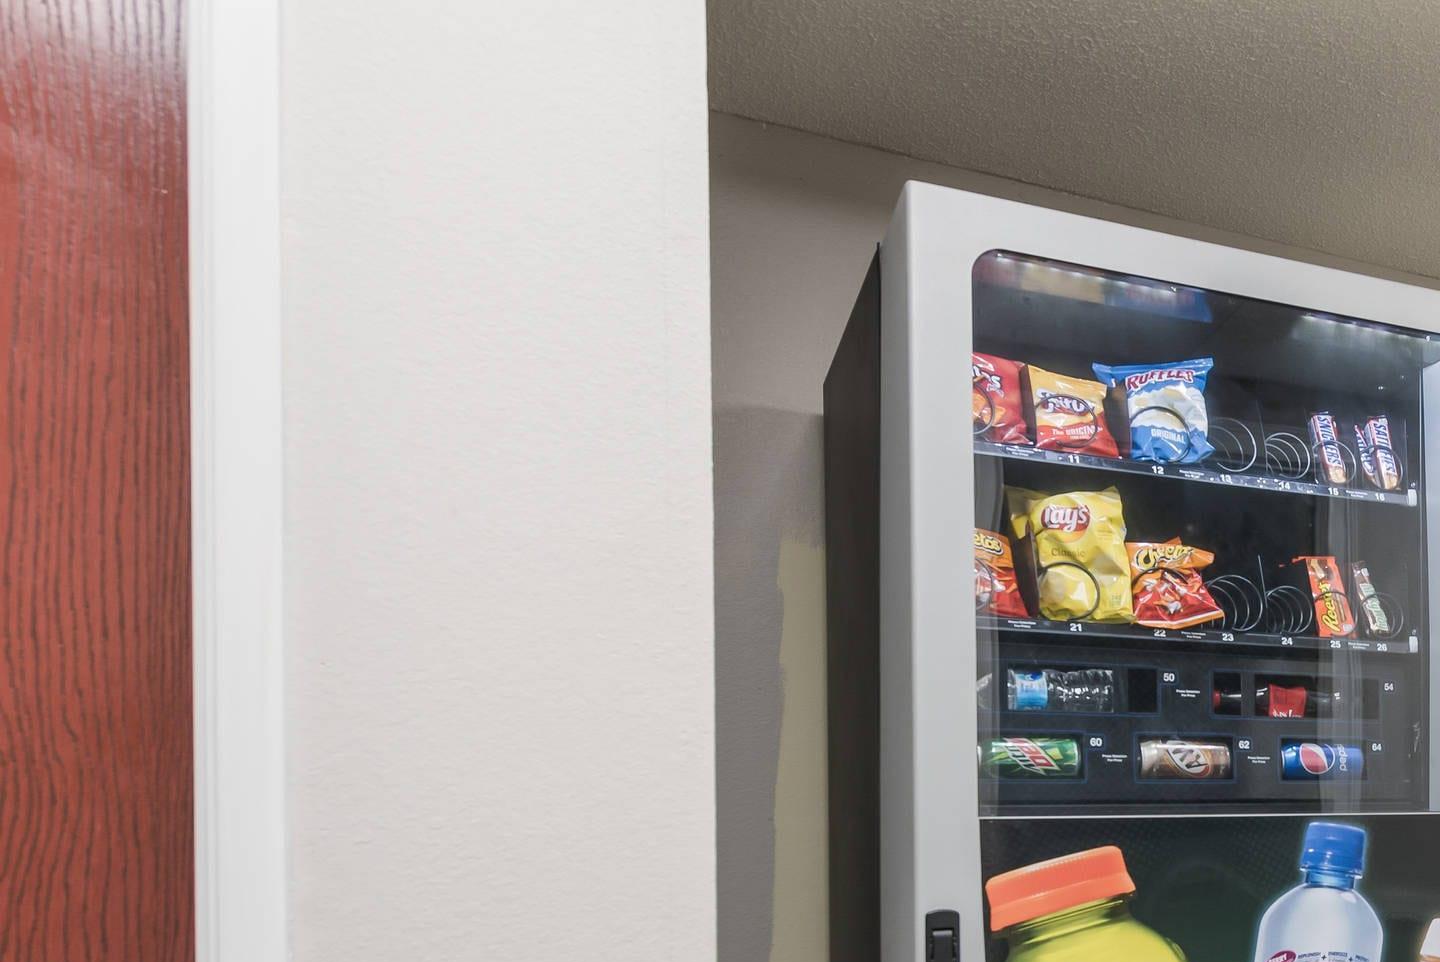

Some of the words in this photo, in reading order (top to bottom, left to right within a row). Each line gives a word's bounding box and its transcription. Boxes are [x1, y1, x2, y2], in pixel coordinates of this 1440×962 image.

[1067, 455, 1081, 464] 11
[1151, 466, 1165, 475] 12
[1044, 503, 1091, 532] Lay's
[1069, 622, 1083, 632] 21
[1154, 629, 1167, 638] 22
[1222, 633, 1235, 642] 23
[1281, 637, 1293, 645] 24
[1330, 640, 1341, 649] 25
[1377, 643, 1387, 652] 26
[1163, 672, 1175, 682] 50
[1384, 682, 1394, 692] 54
[1089, 737, 1103, 748] 60
[1238, 740, 1250, 750] 62
[1371, 742, 1382, 751] 64
